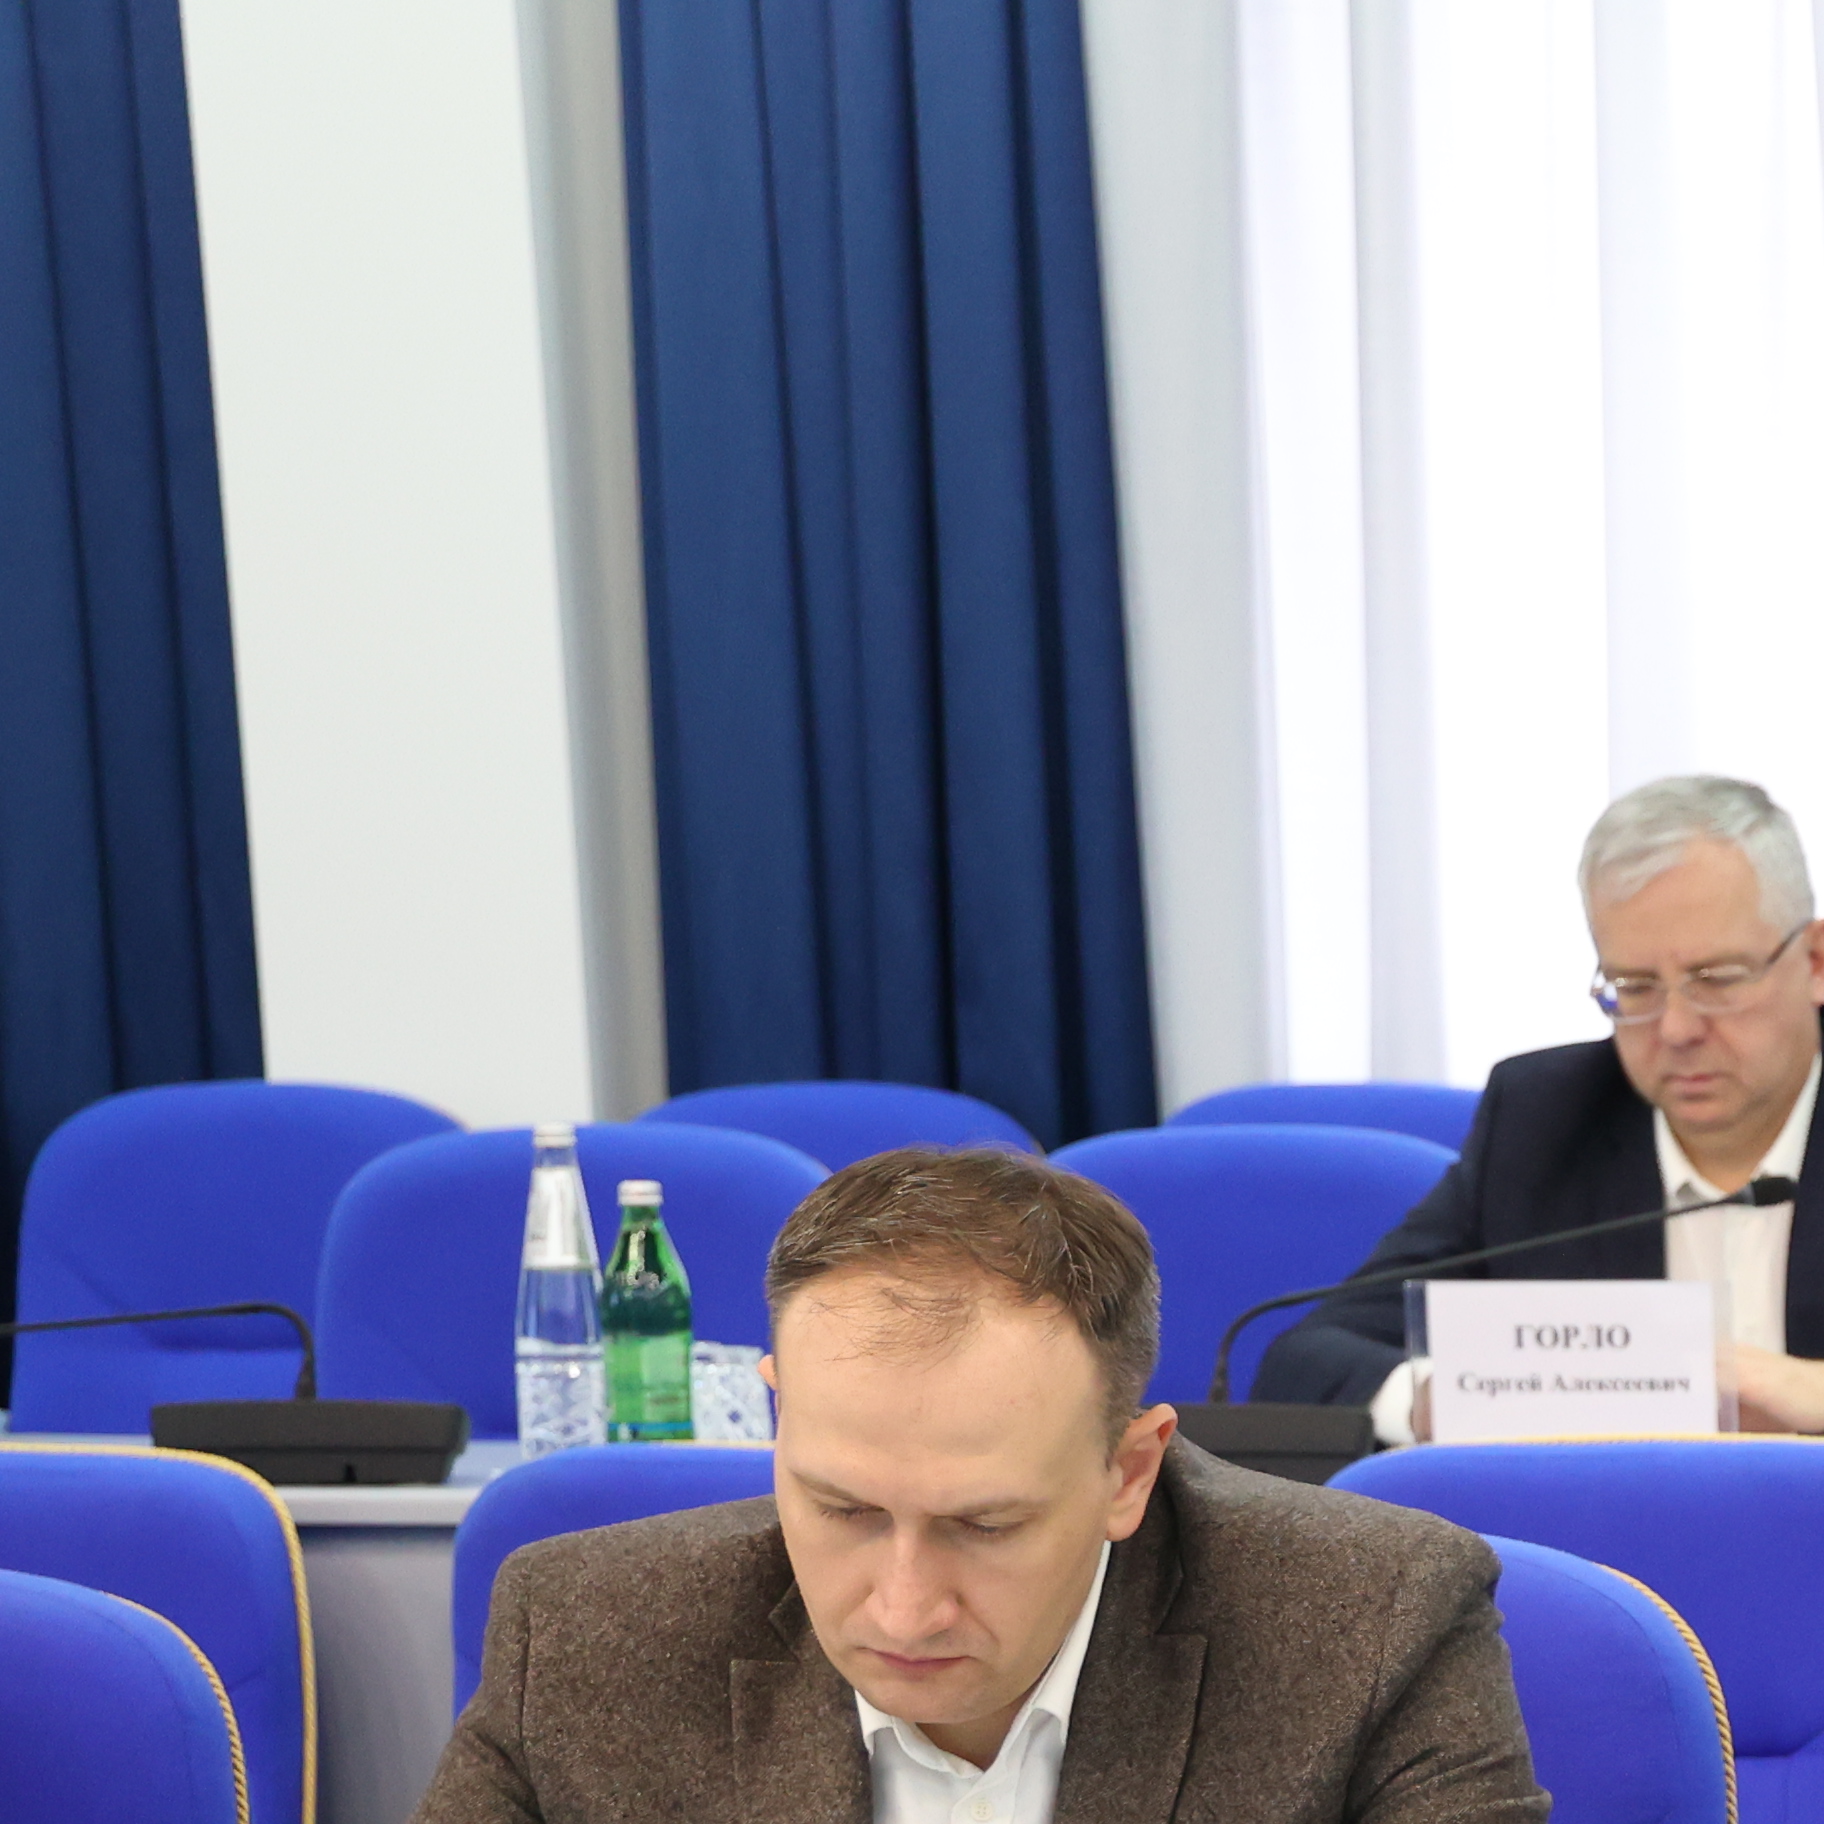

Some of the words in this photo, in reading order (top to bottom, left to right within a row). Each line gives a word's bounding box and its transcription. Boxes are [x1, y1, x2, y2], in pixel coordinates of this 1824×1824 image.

[1513, 1324, 1633, 1350] ГОРЛО
[1456, 1371, 1543, 1397] Сергей
[1553, 1374, 1691, 1394] Алексеевич
